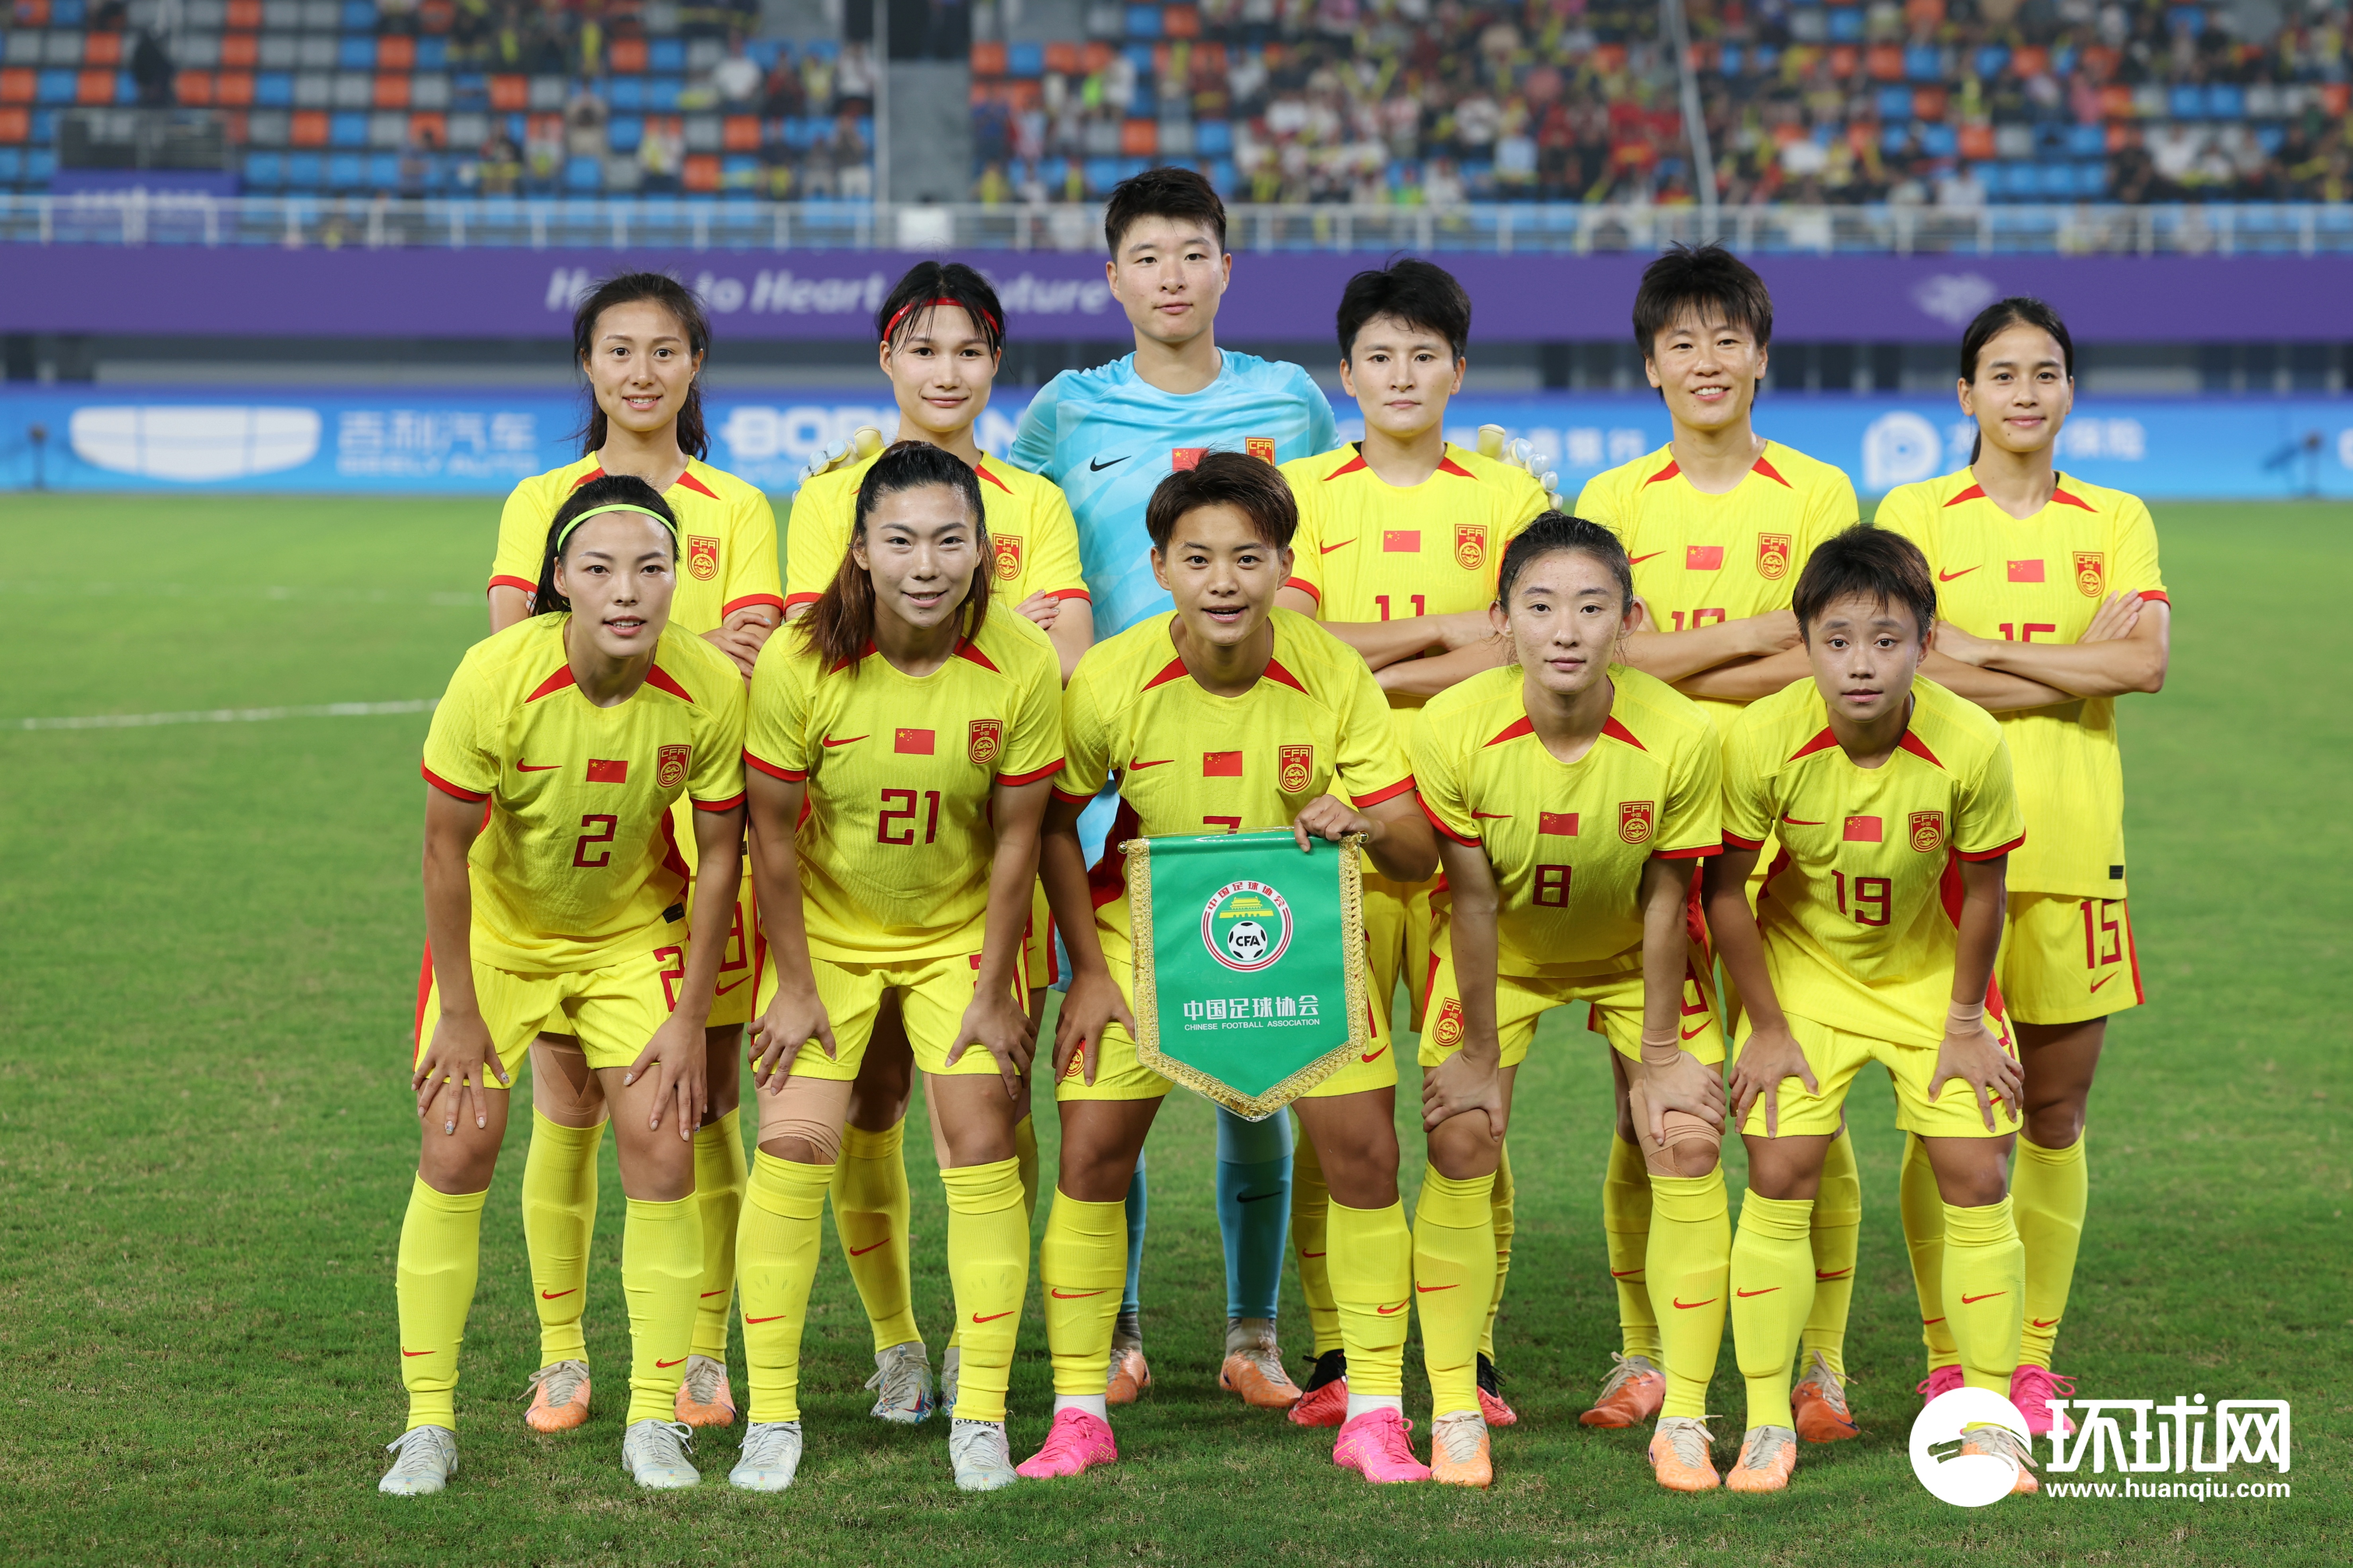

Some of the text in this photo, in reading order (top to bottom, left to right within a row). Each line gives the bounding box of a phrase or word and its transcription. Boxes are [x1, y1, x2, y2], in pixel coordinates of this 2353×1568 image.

[1249, 442, 1271, 450] CFA
[1459, 528, 1483, 537] CFA
[692, 539, 715, 549] CFA
[996, 538, 1018, 548] CFA
[1762, 537, 1787, 546] CFA
[2077, 555, 2100, 565] CFA
[973, 723, 997, 732] CFA
[662, 748, 686, 757] CFA
[1283, 749, 1308, 757] CFA
[877, 788, 940, 845] 21
[1913, 814, 1939, 823] CFA
[572, 814, 617, 867] 2
[1533, 864, 1572, 908] 8
[1208, 882, 1285, 910] 中国足球协会
[1831, 869, 1892, 927] 19
[2080, 899, 2122, 969] 15
[1235, 935, 1261, 946] CFA
[1183, 995, 1319, 1021] 中国足球协会
[1184, 1019, 1320, 1031] CHINESE FOOTBALL ASSOCIATION
